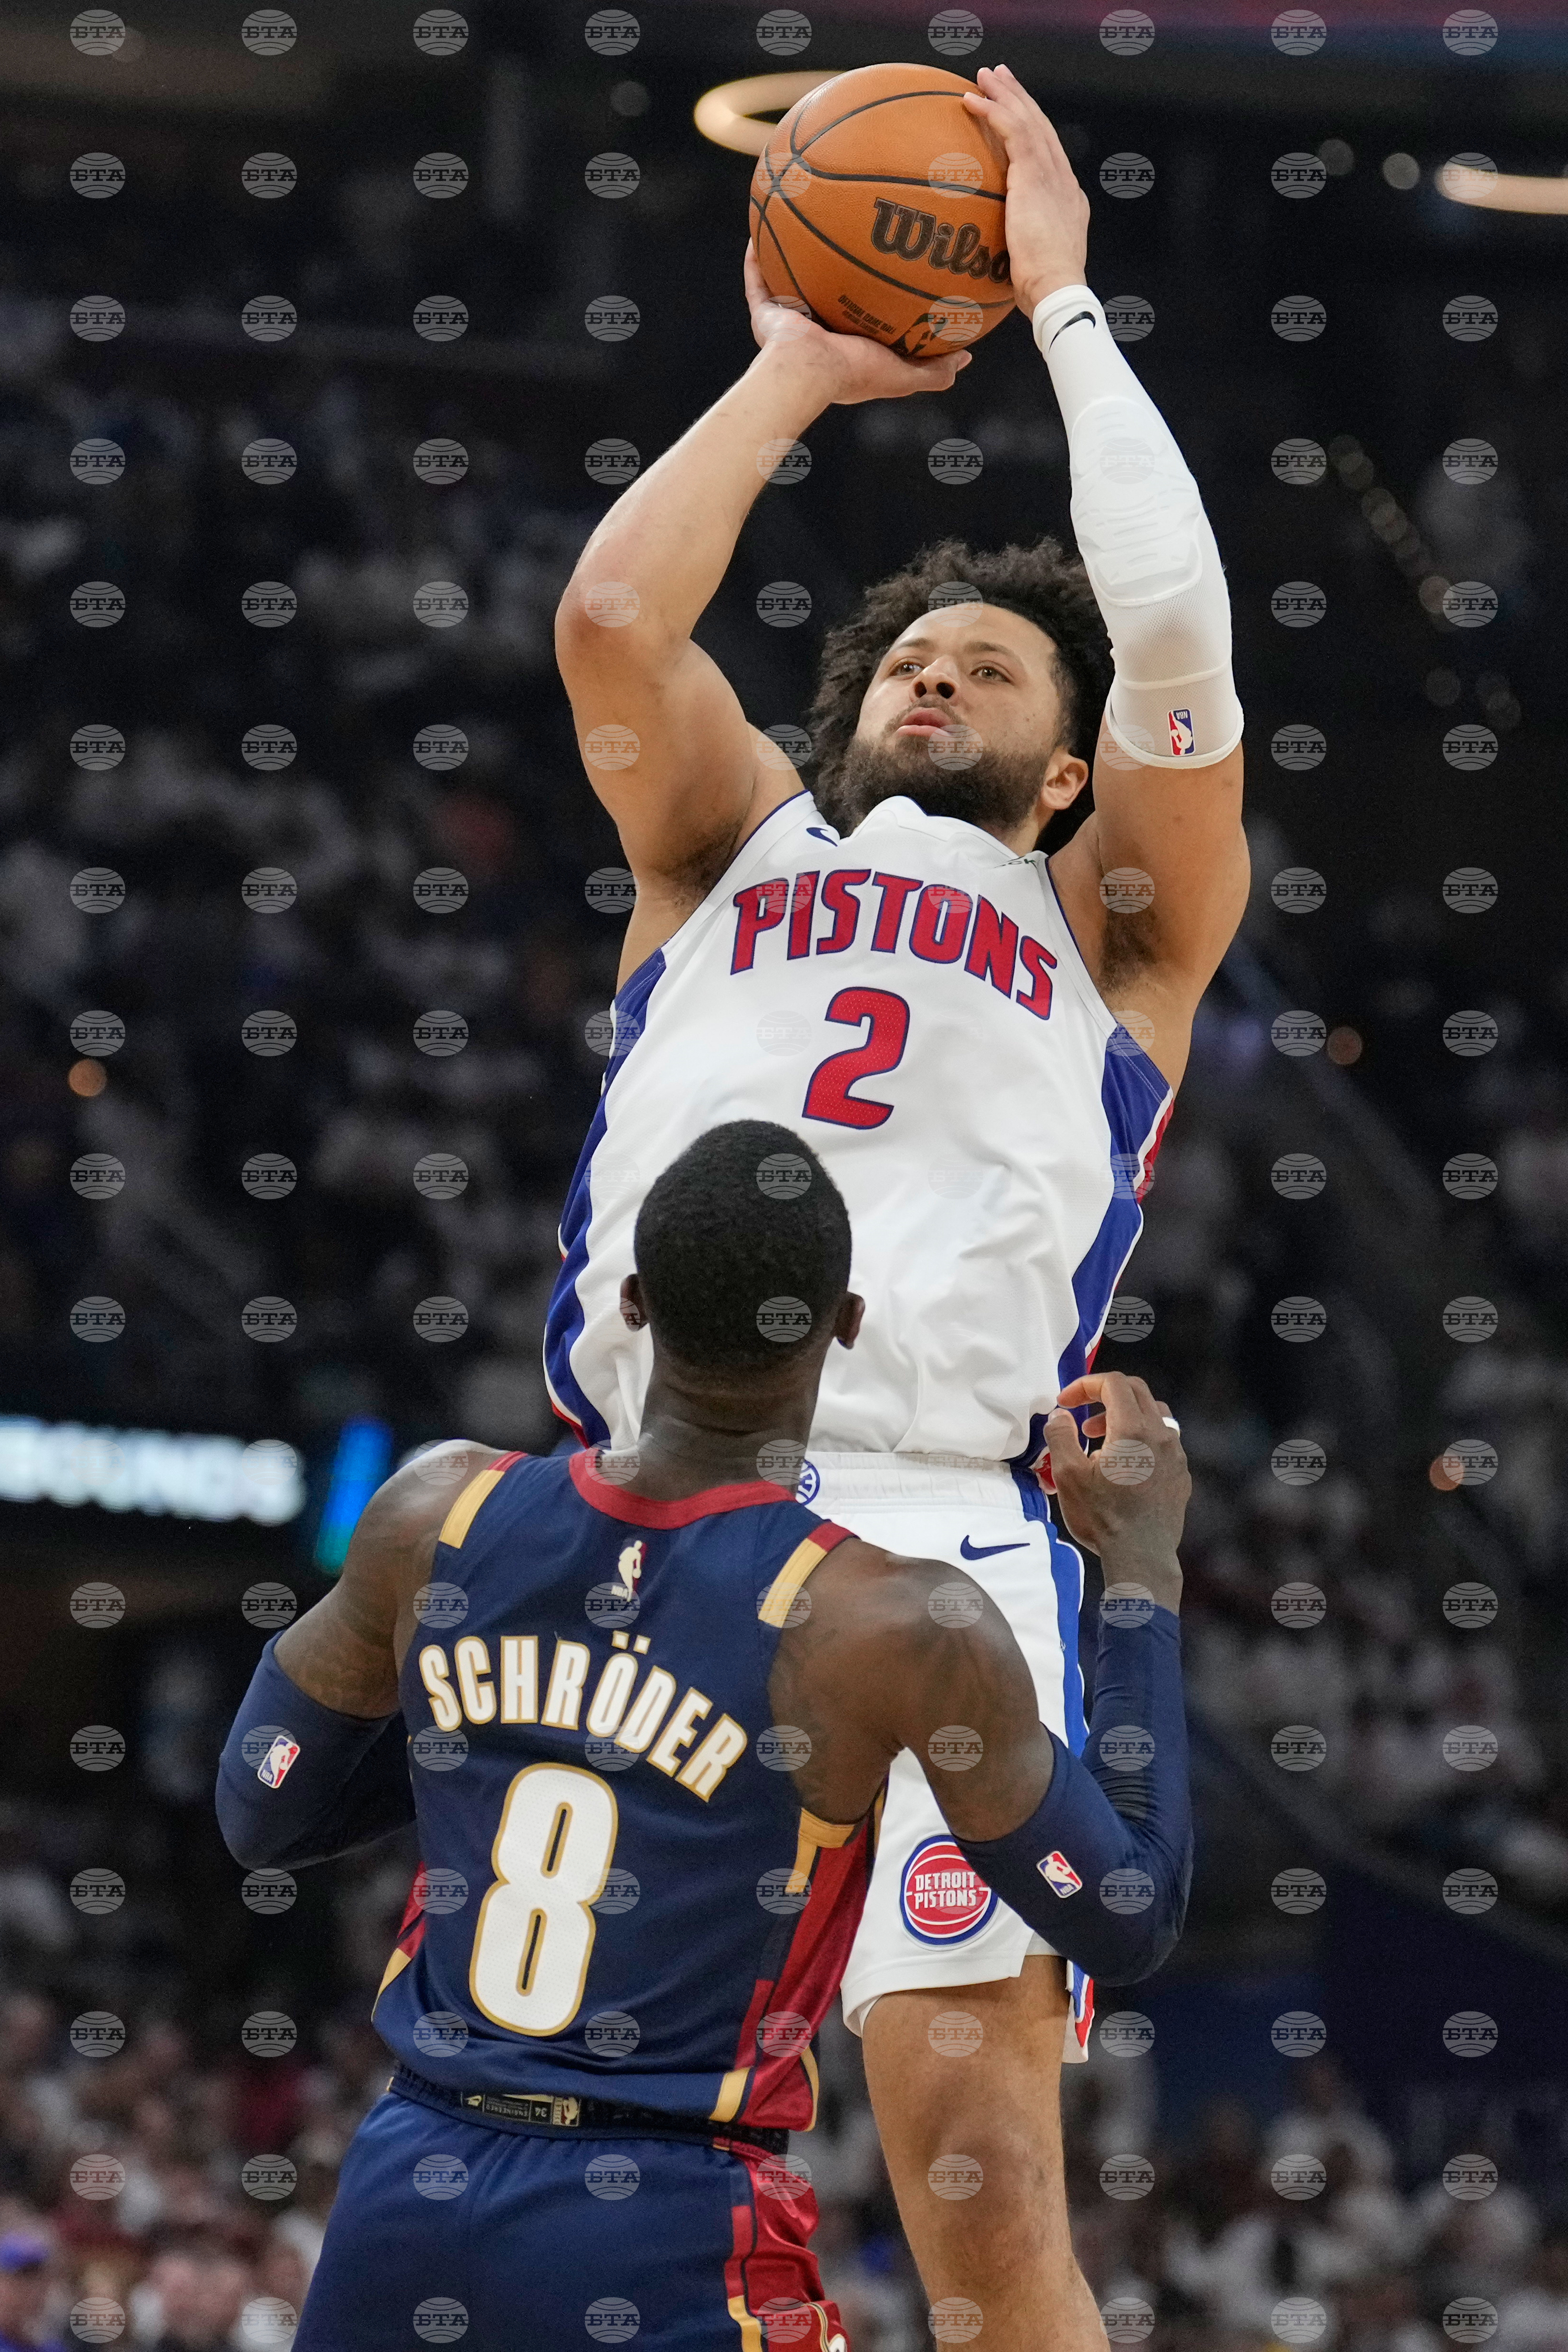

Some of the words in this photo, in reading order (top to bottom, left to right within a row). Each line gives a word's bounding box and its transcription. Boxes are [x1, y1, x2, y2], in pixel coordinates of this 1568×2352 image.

[870, 197, 1013, 285] Wilso
[1175, 711, 1188, 720] NBA
[730, 869, 1057, 1020] PISTONS
[802, 986, 910, 1130] 2
[611, 1586, 628, 1598] NBA
[419, 1630, 747, 1802] SCHRÖDER
[262, 1770, 273, 1782] NBA
[914, 1872, 976, 1891] DETROIT
[1059, 1884, 1073, 1895] NBA
[469, 1762, 618, 2036] 8
[914, 1889, 977, 1910] PISTONS
